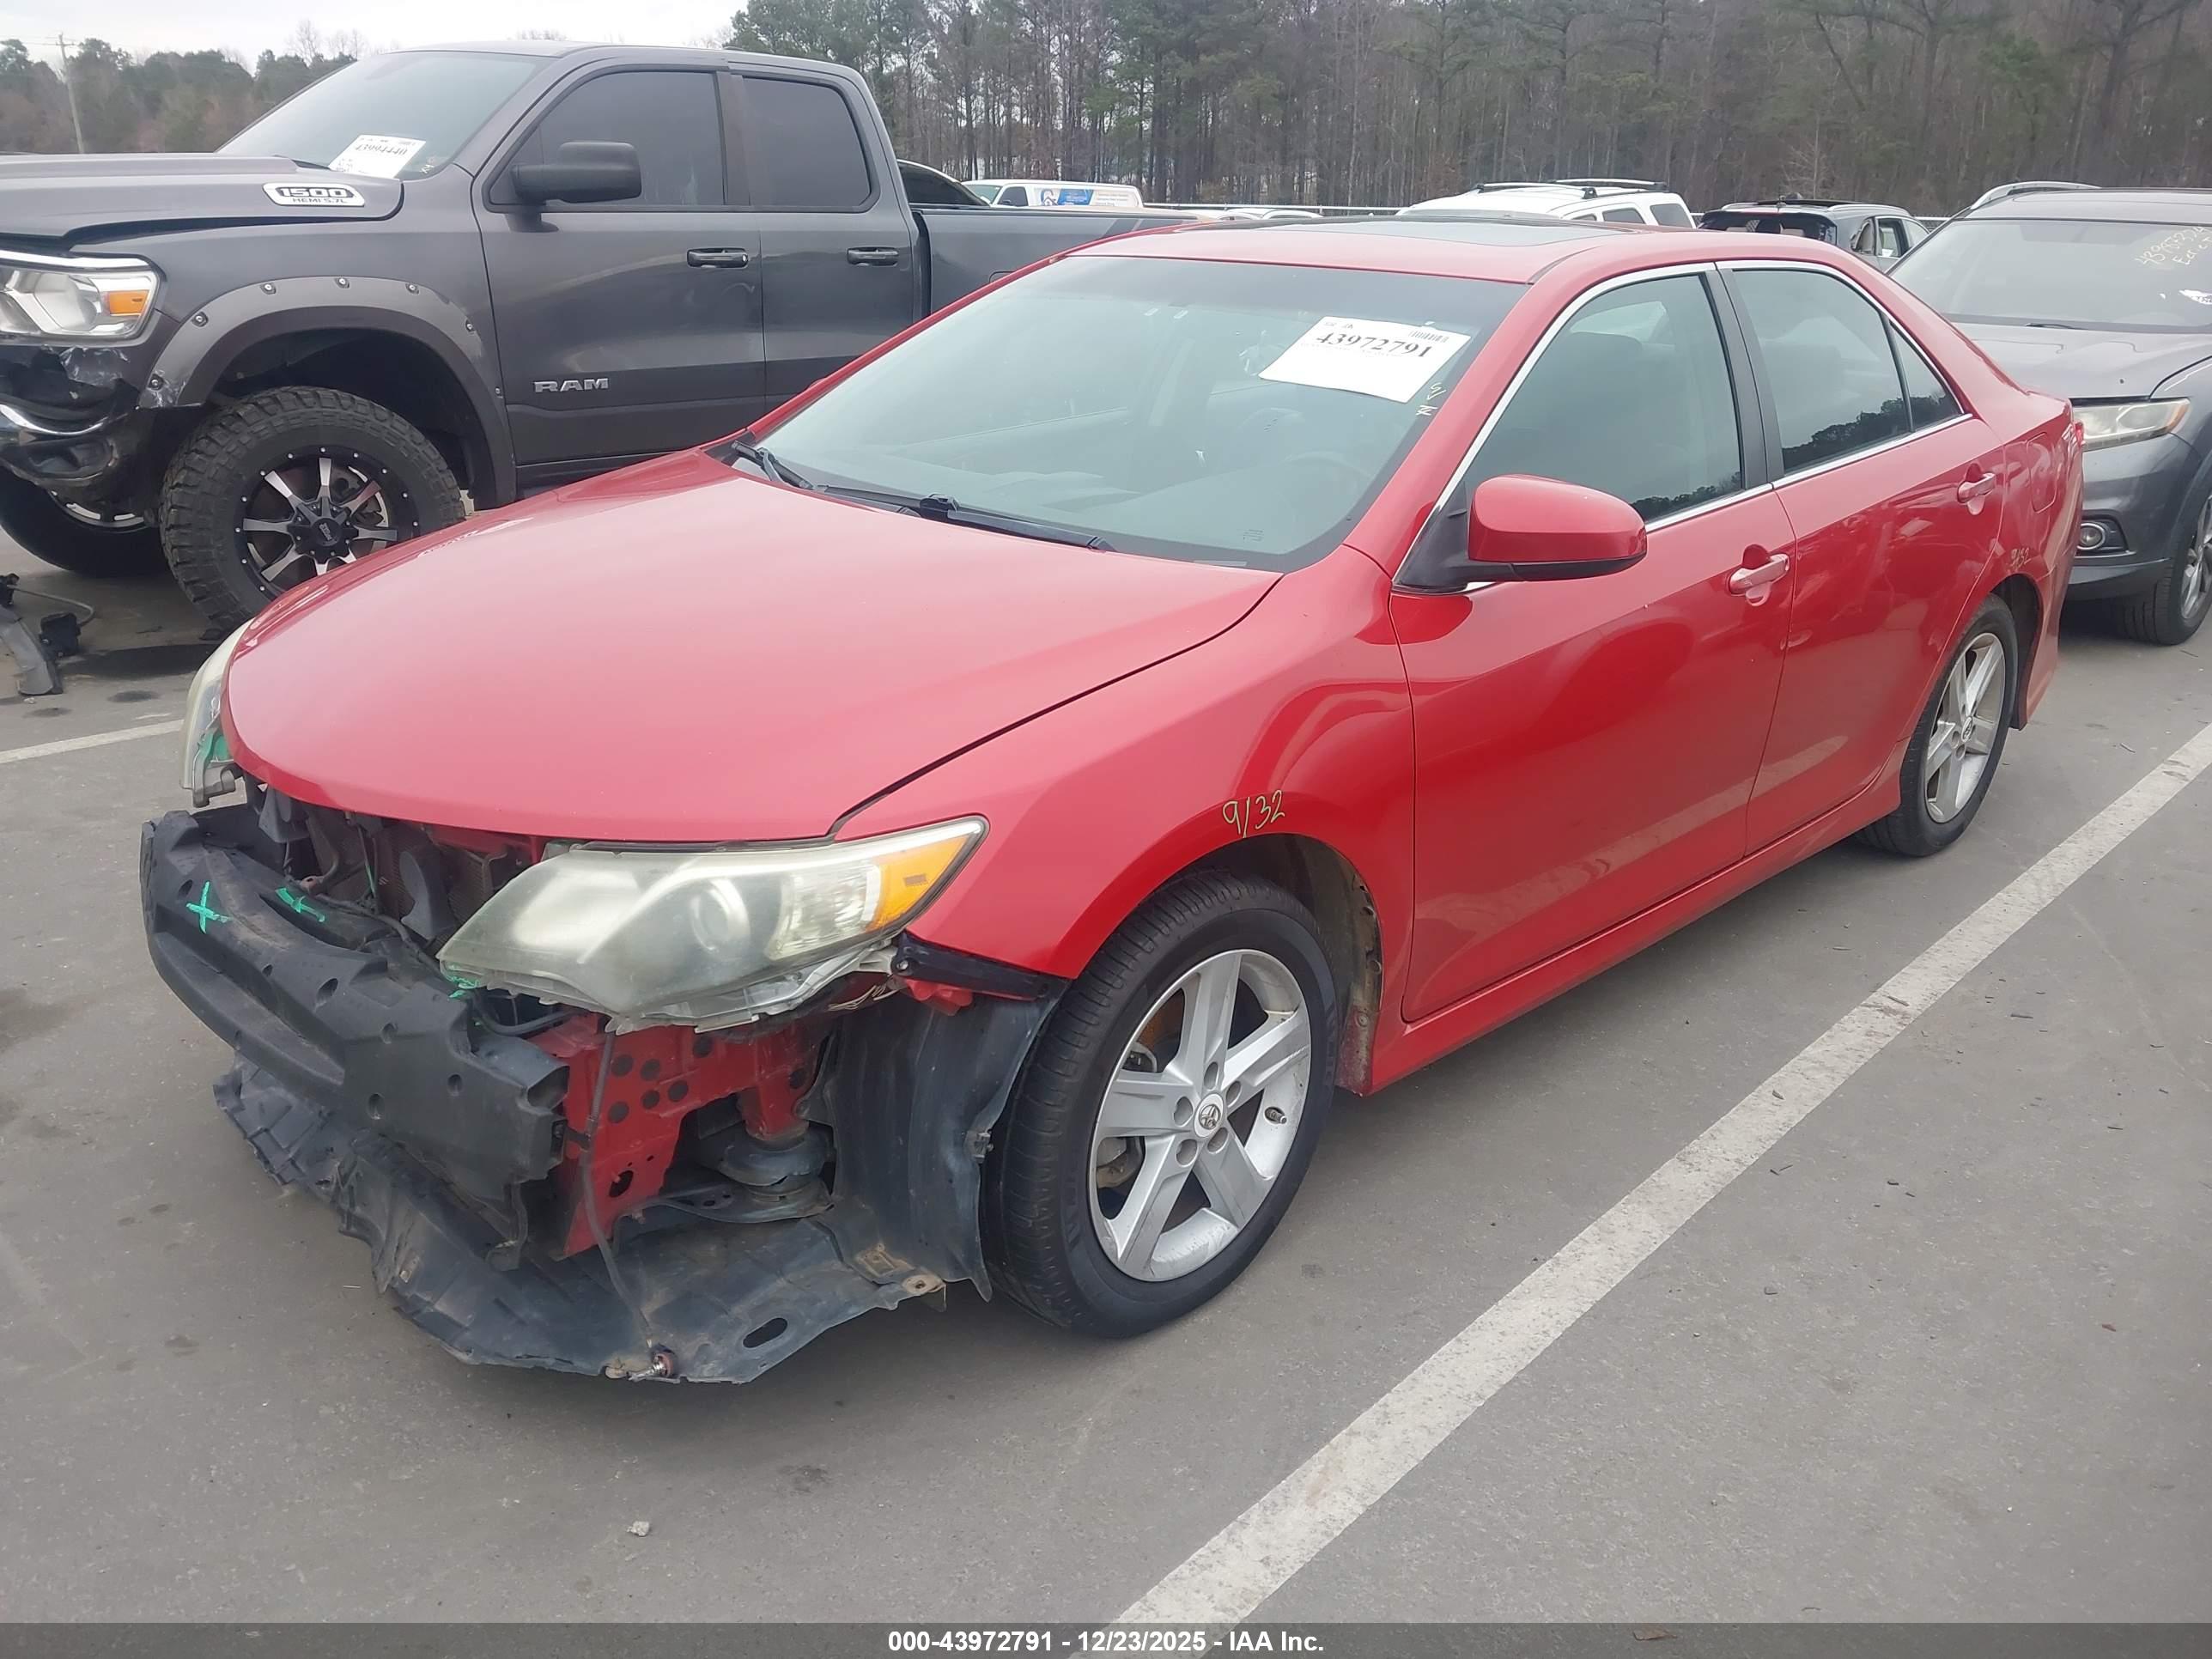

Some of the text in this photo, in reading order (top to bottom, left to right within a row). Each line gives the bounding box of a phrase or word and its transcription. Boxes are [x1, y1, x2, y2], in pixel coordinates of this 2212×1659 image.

[278, 188, 348, 198] 1500
[1316, 331, 1433, 358] 43972791
[533, 378, 610, 393] RAM
